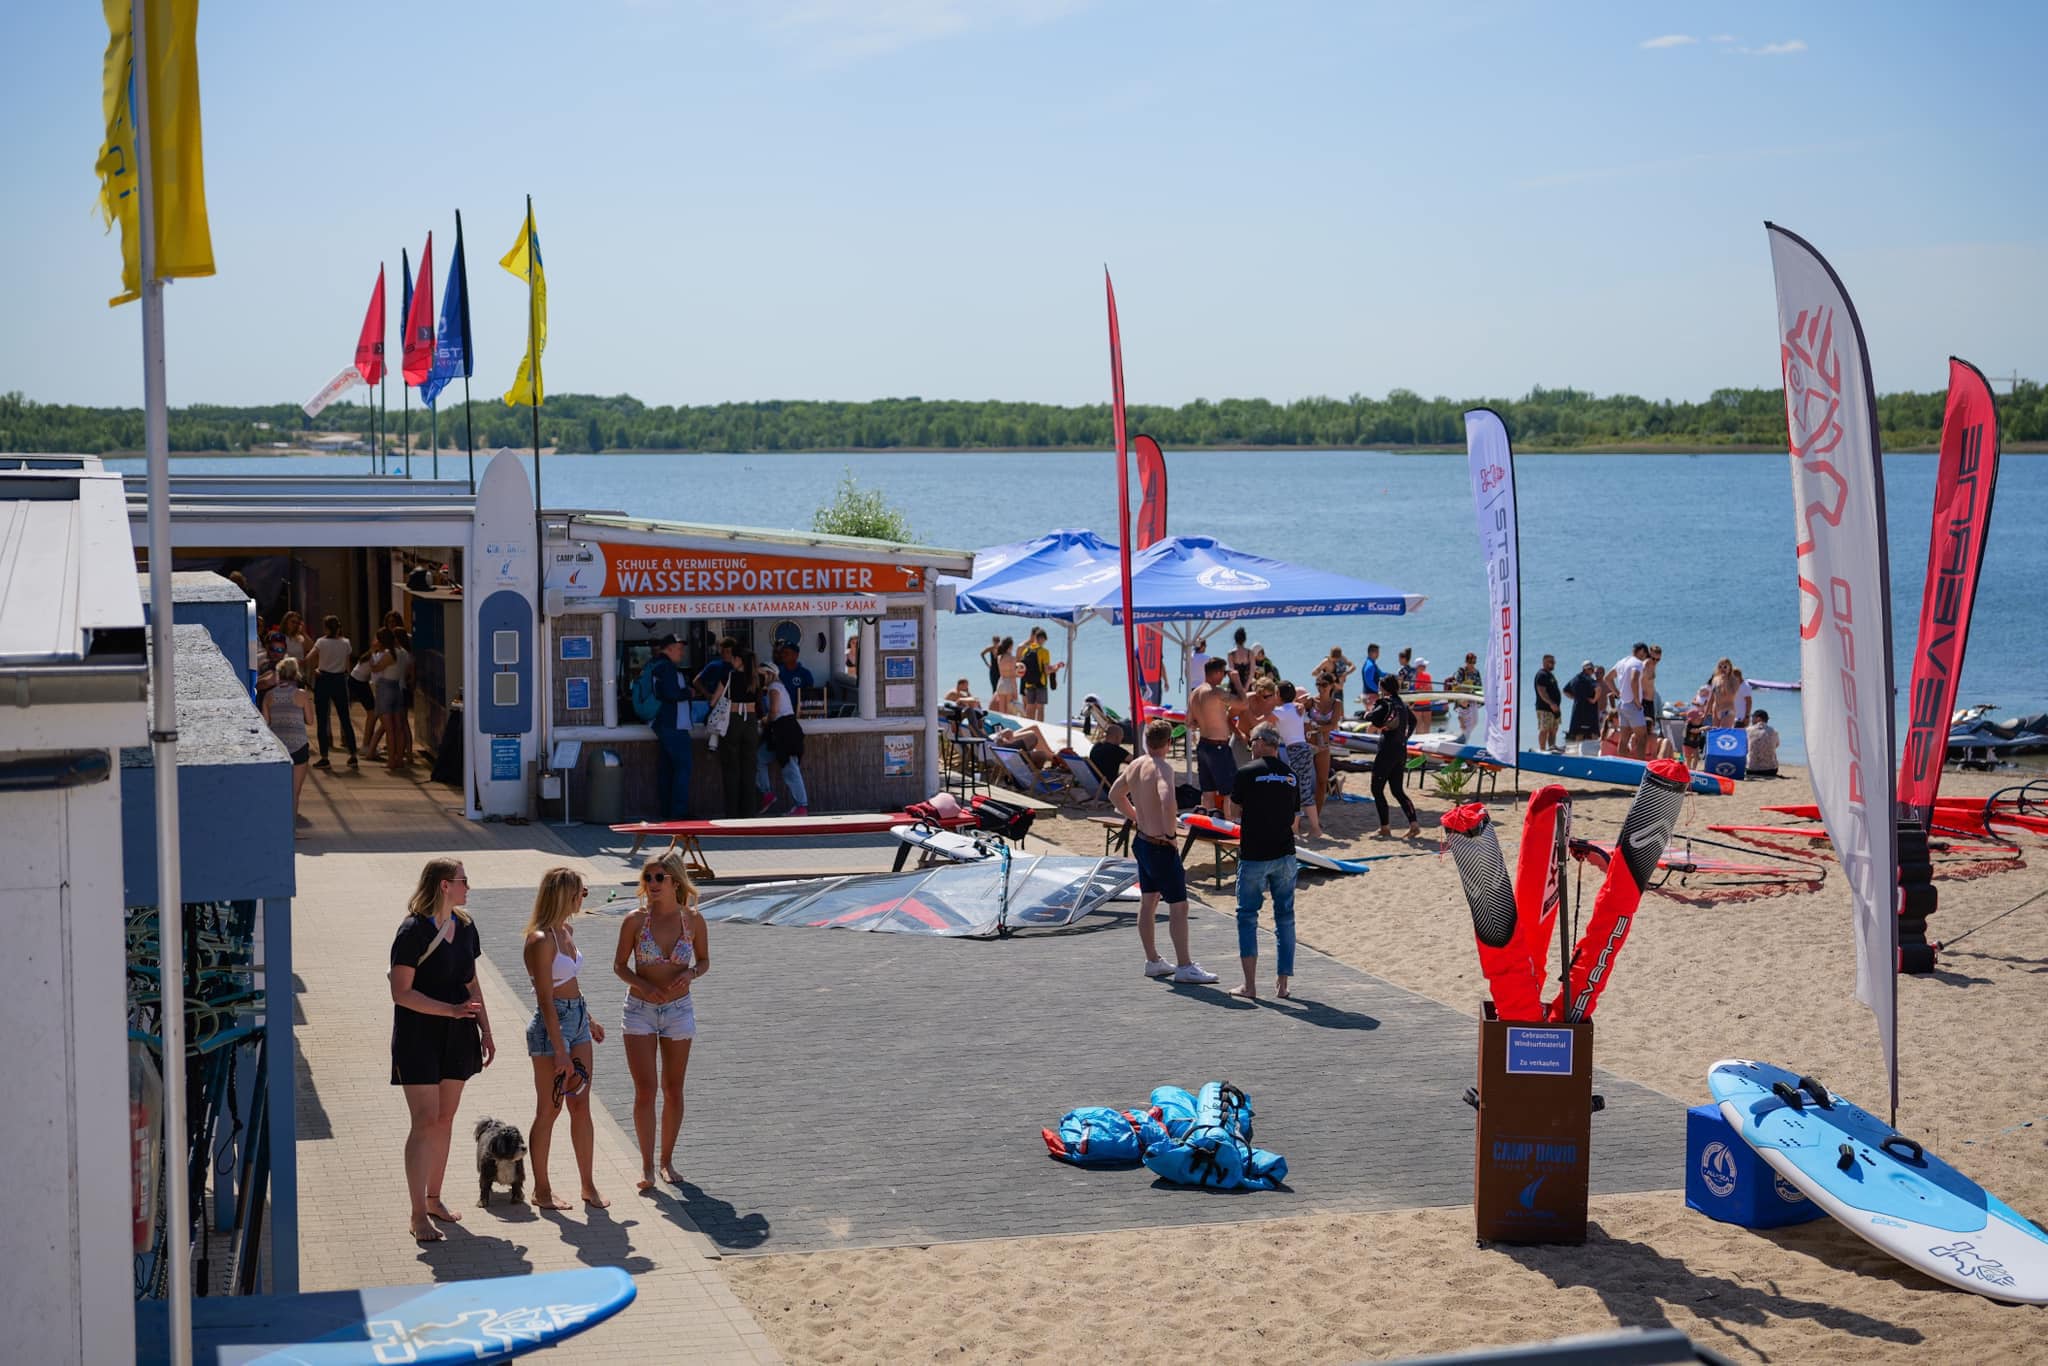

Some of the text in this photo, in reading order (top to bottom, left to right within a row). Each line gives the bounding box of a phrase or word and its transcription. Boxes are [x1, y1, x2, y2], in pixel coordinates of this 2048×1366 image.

[616, 558, 747, 570] SCHULE & VERMIETUNG
[616, 568, 873, 593] WASSERSPORTCENTER
[644, 600, 877, 614] SURFEN SEGELN KATAMARAN SUP KAJAK
[1367, 601, 1401, 612] Kanu
[1493, 1141, 1533, 1161] CAMP
